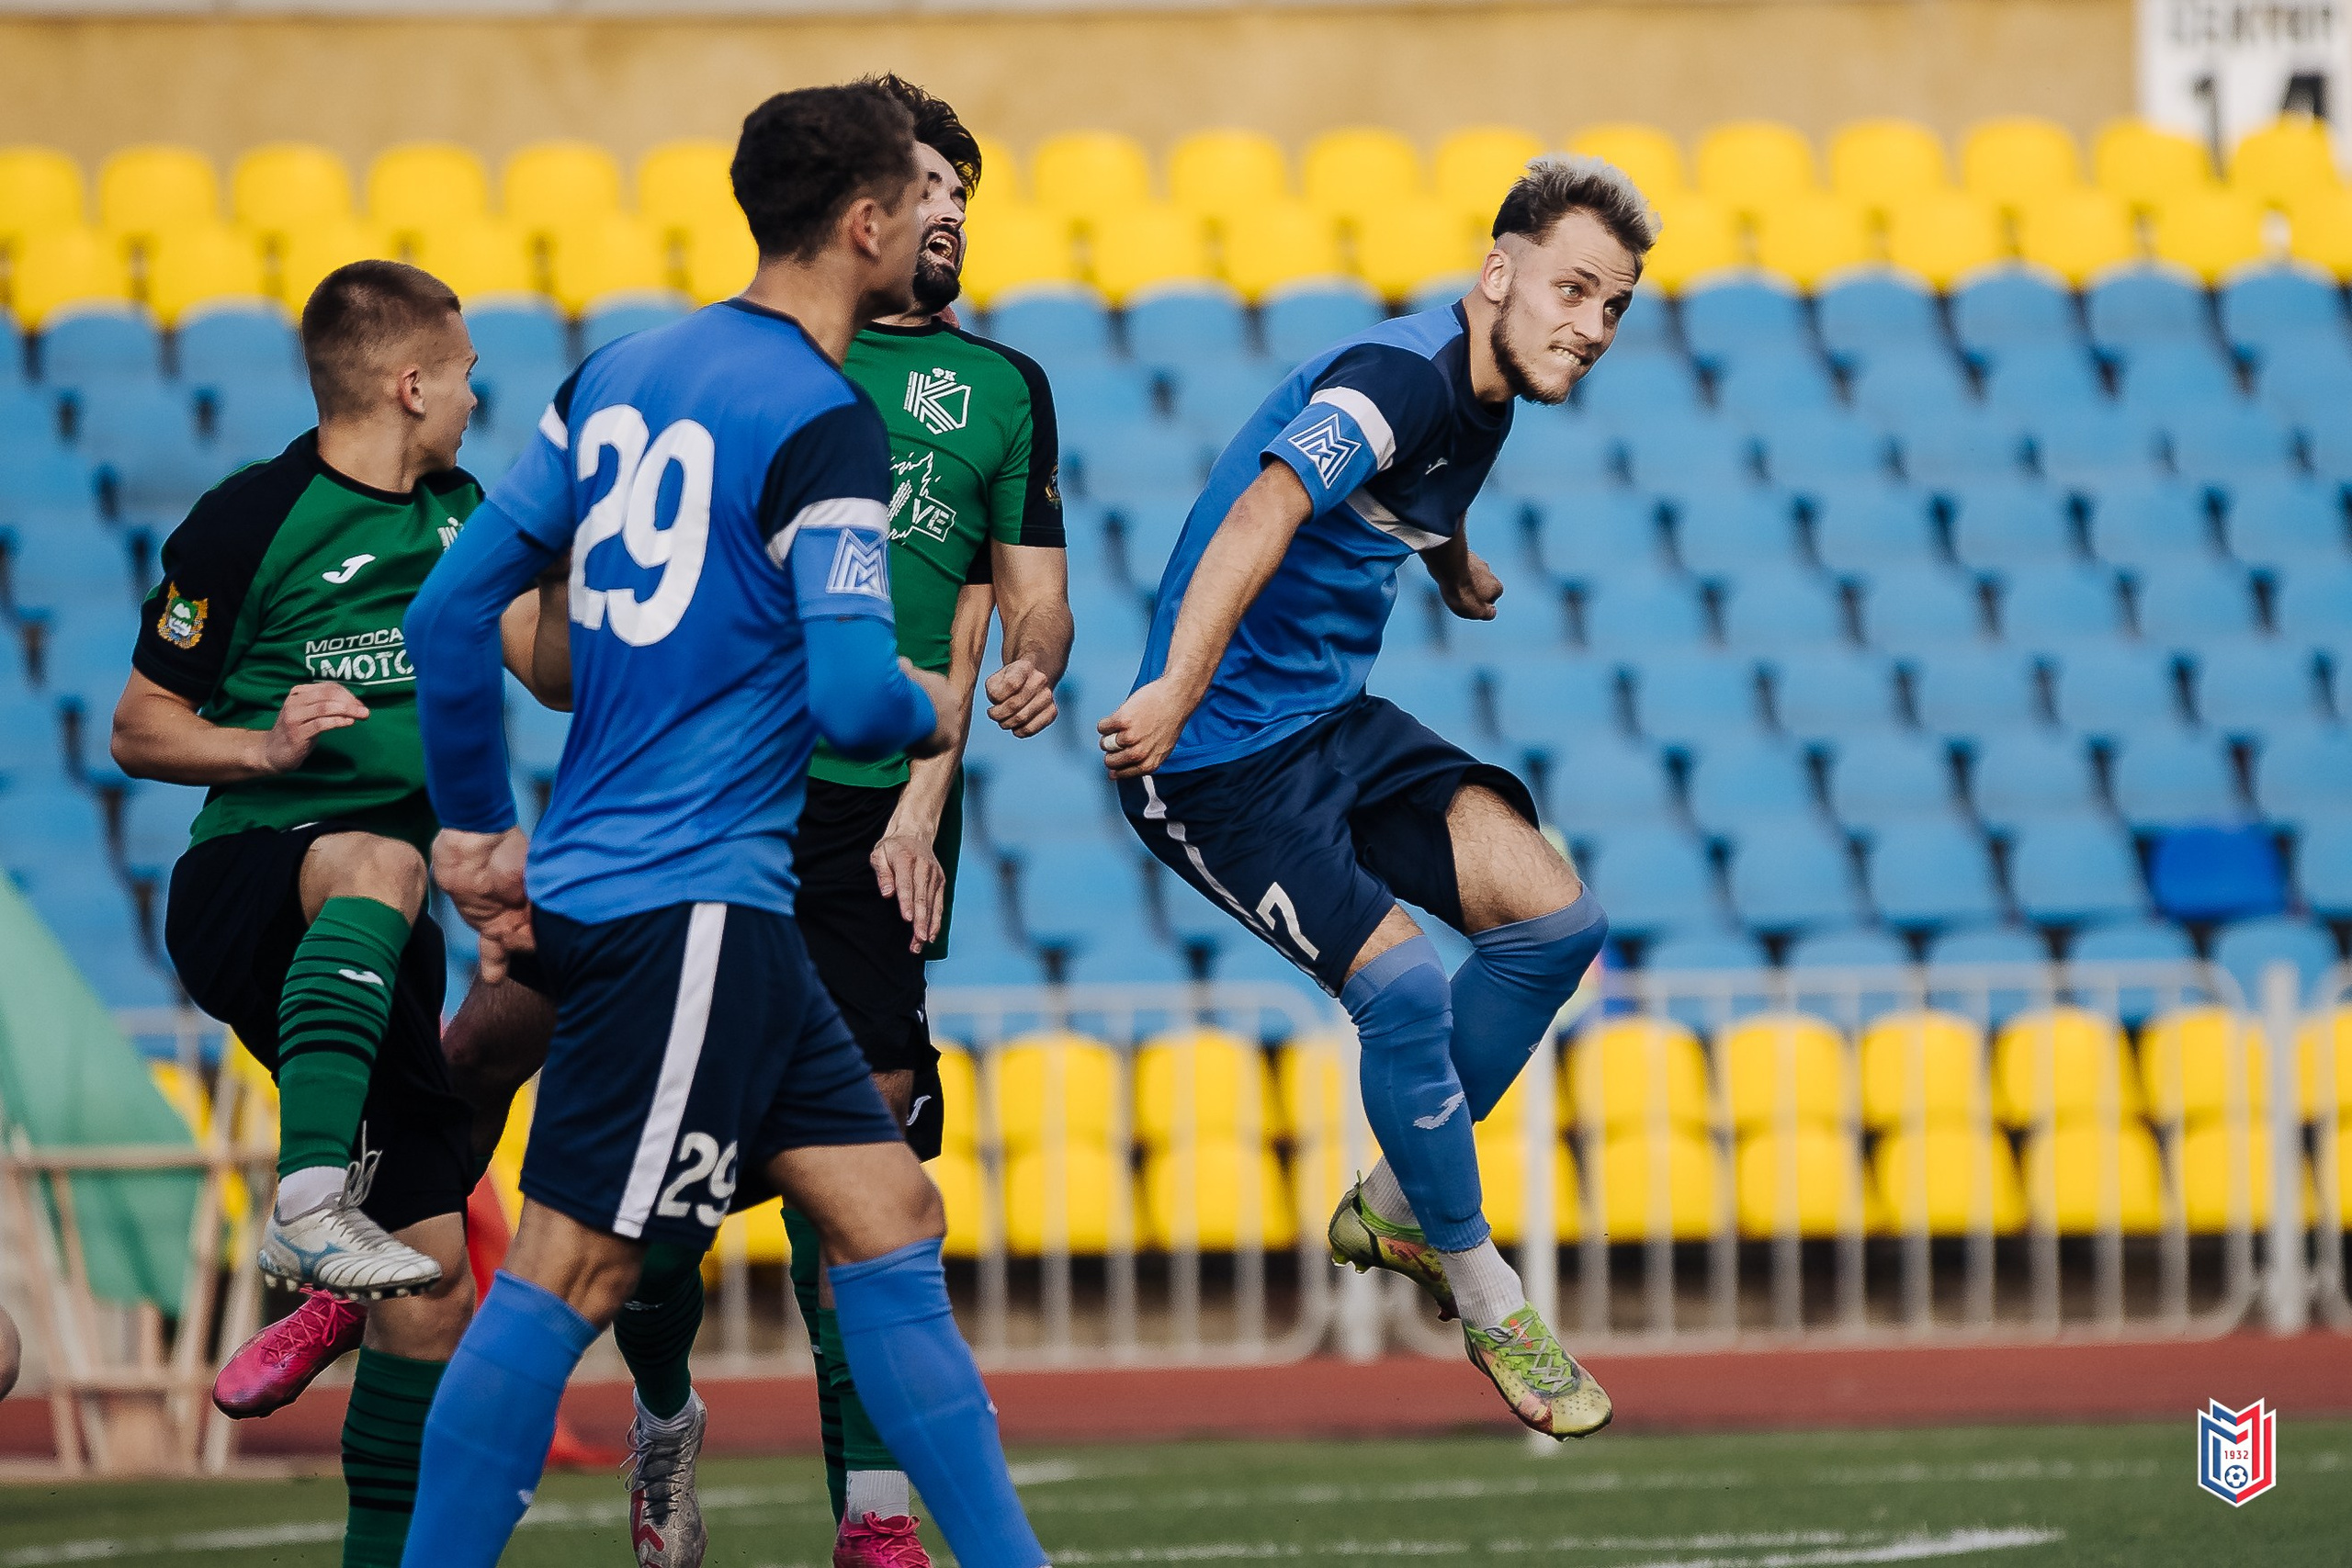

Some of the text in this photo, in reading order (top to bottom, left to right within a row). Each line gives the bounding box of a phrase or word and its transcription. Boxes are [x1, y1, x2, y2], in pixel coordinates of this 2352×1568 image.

[569, 403, 715, 647] 29
[1256, 882, 1320, 961] 7
[655, 1131, 738, 1227] 29
